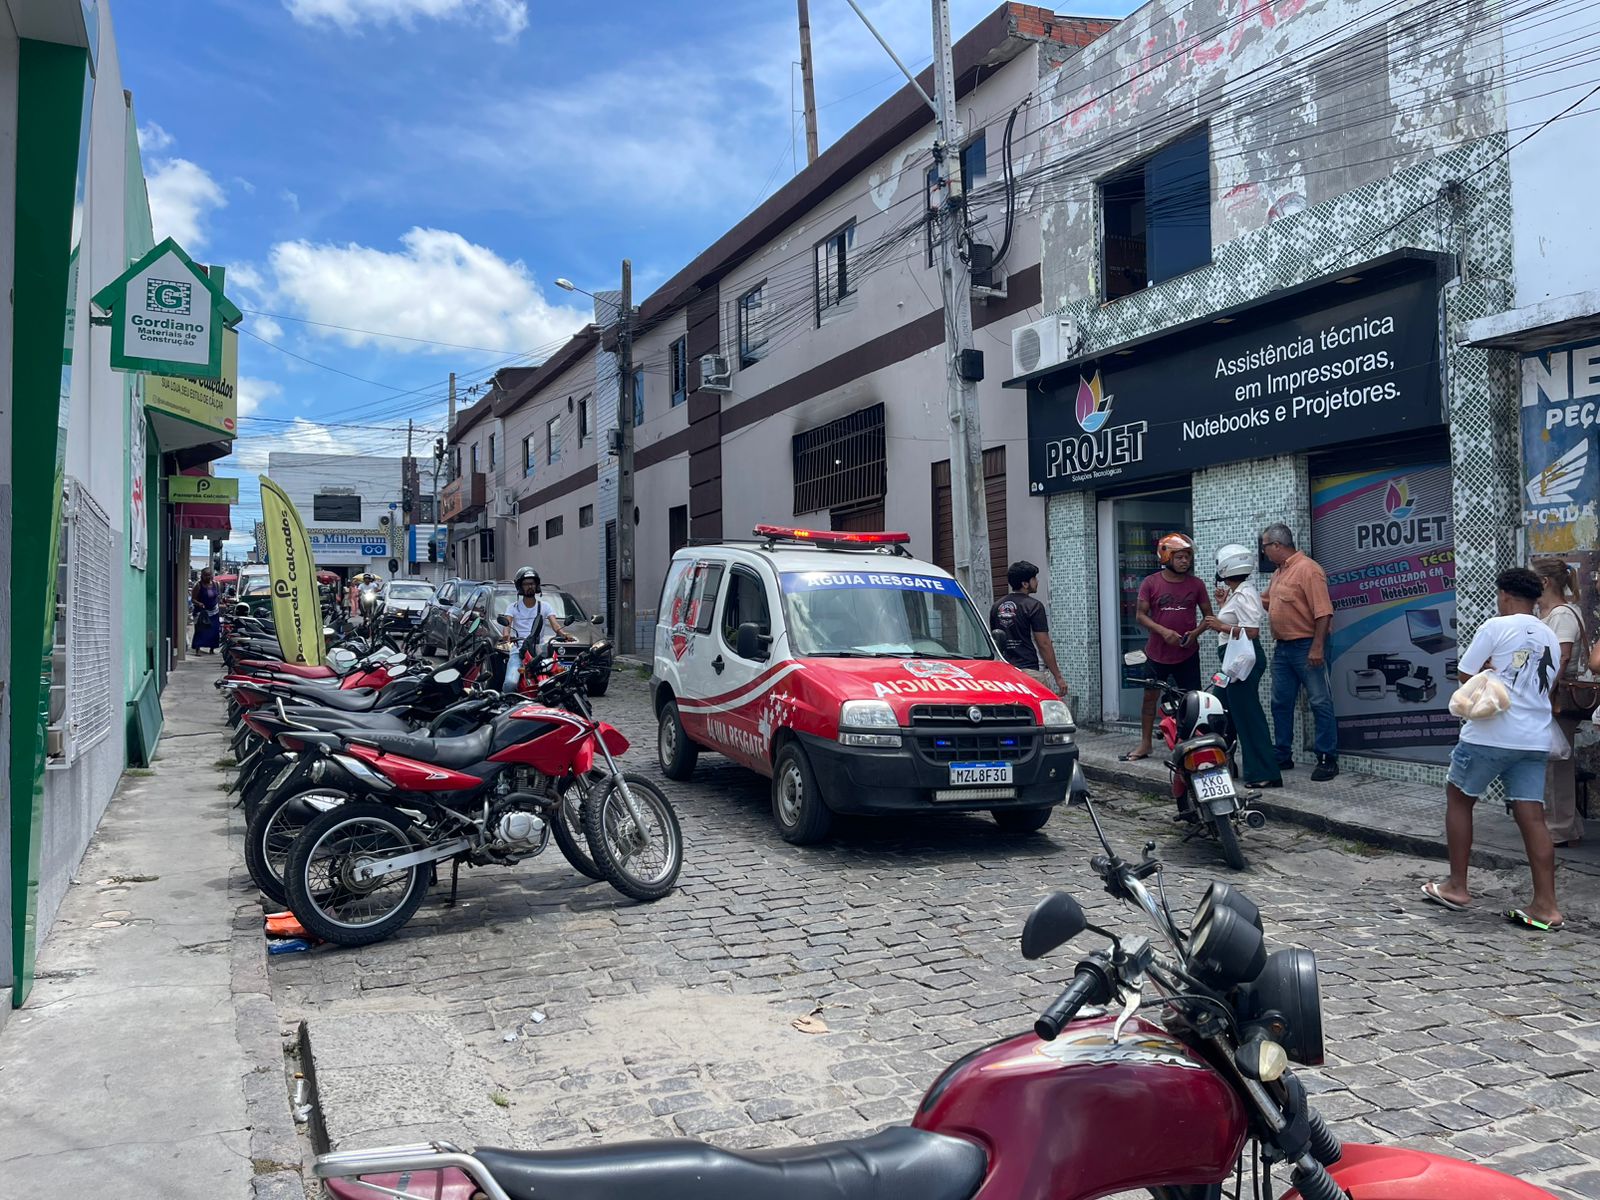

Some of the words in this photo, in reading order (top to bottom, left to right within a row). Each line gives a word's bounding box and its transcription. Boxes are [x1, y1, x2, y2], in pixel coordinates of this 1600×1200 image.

[131, 315, 204, 332] Gordiano
[138, 327, 182, 338] Materiais
[140, 333, 195, 346] Construção
[1215, 336, 1314, 379] Assistência
[1320, 315, 1394, 351] técnica
[1235, 381, 1261, 401] em
[1267, 350, 1395, 395] Impressoras,
[1183, 407, 1270, 441] Notebooks
[1274, 405, 1286, 422] e
[1293, 381, 1401, 419] Projetores.
[1546, 402, 1600, 430] PEÇ
[1045, 420, 1148, 479] PROJET
[1072, 472, 1092, 482] Soluções
[1093, 467, 1122, 479] Tecnológicas
[323, 534, 386, 544] Millenium
[1357, 516, 1447, 549] PROJET
[868, 574, 945, 590] RESGATE
[1360, 570, 1426, 590] ESPECIALIZADA
[1429, 566, 1444, 577] EM
[1381, 581, 1429, 601] Notebooks
[728, 724, 764, 760] RESGATE
[956, 768, 1007, 783] MZL8F30
[1201, 784, 1231, 798] 2D30
